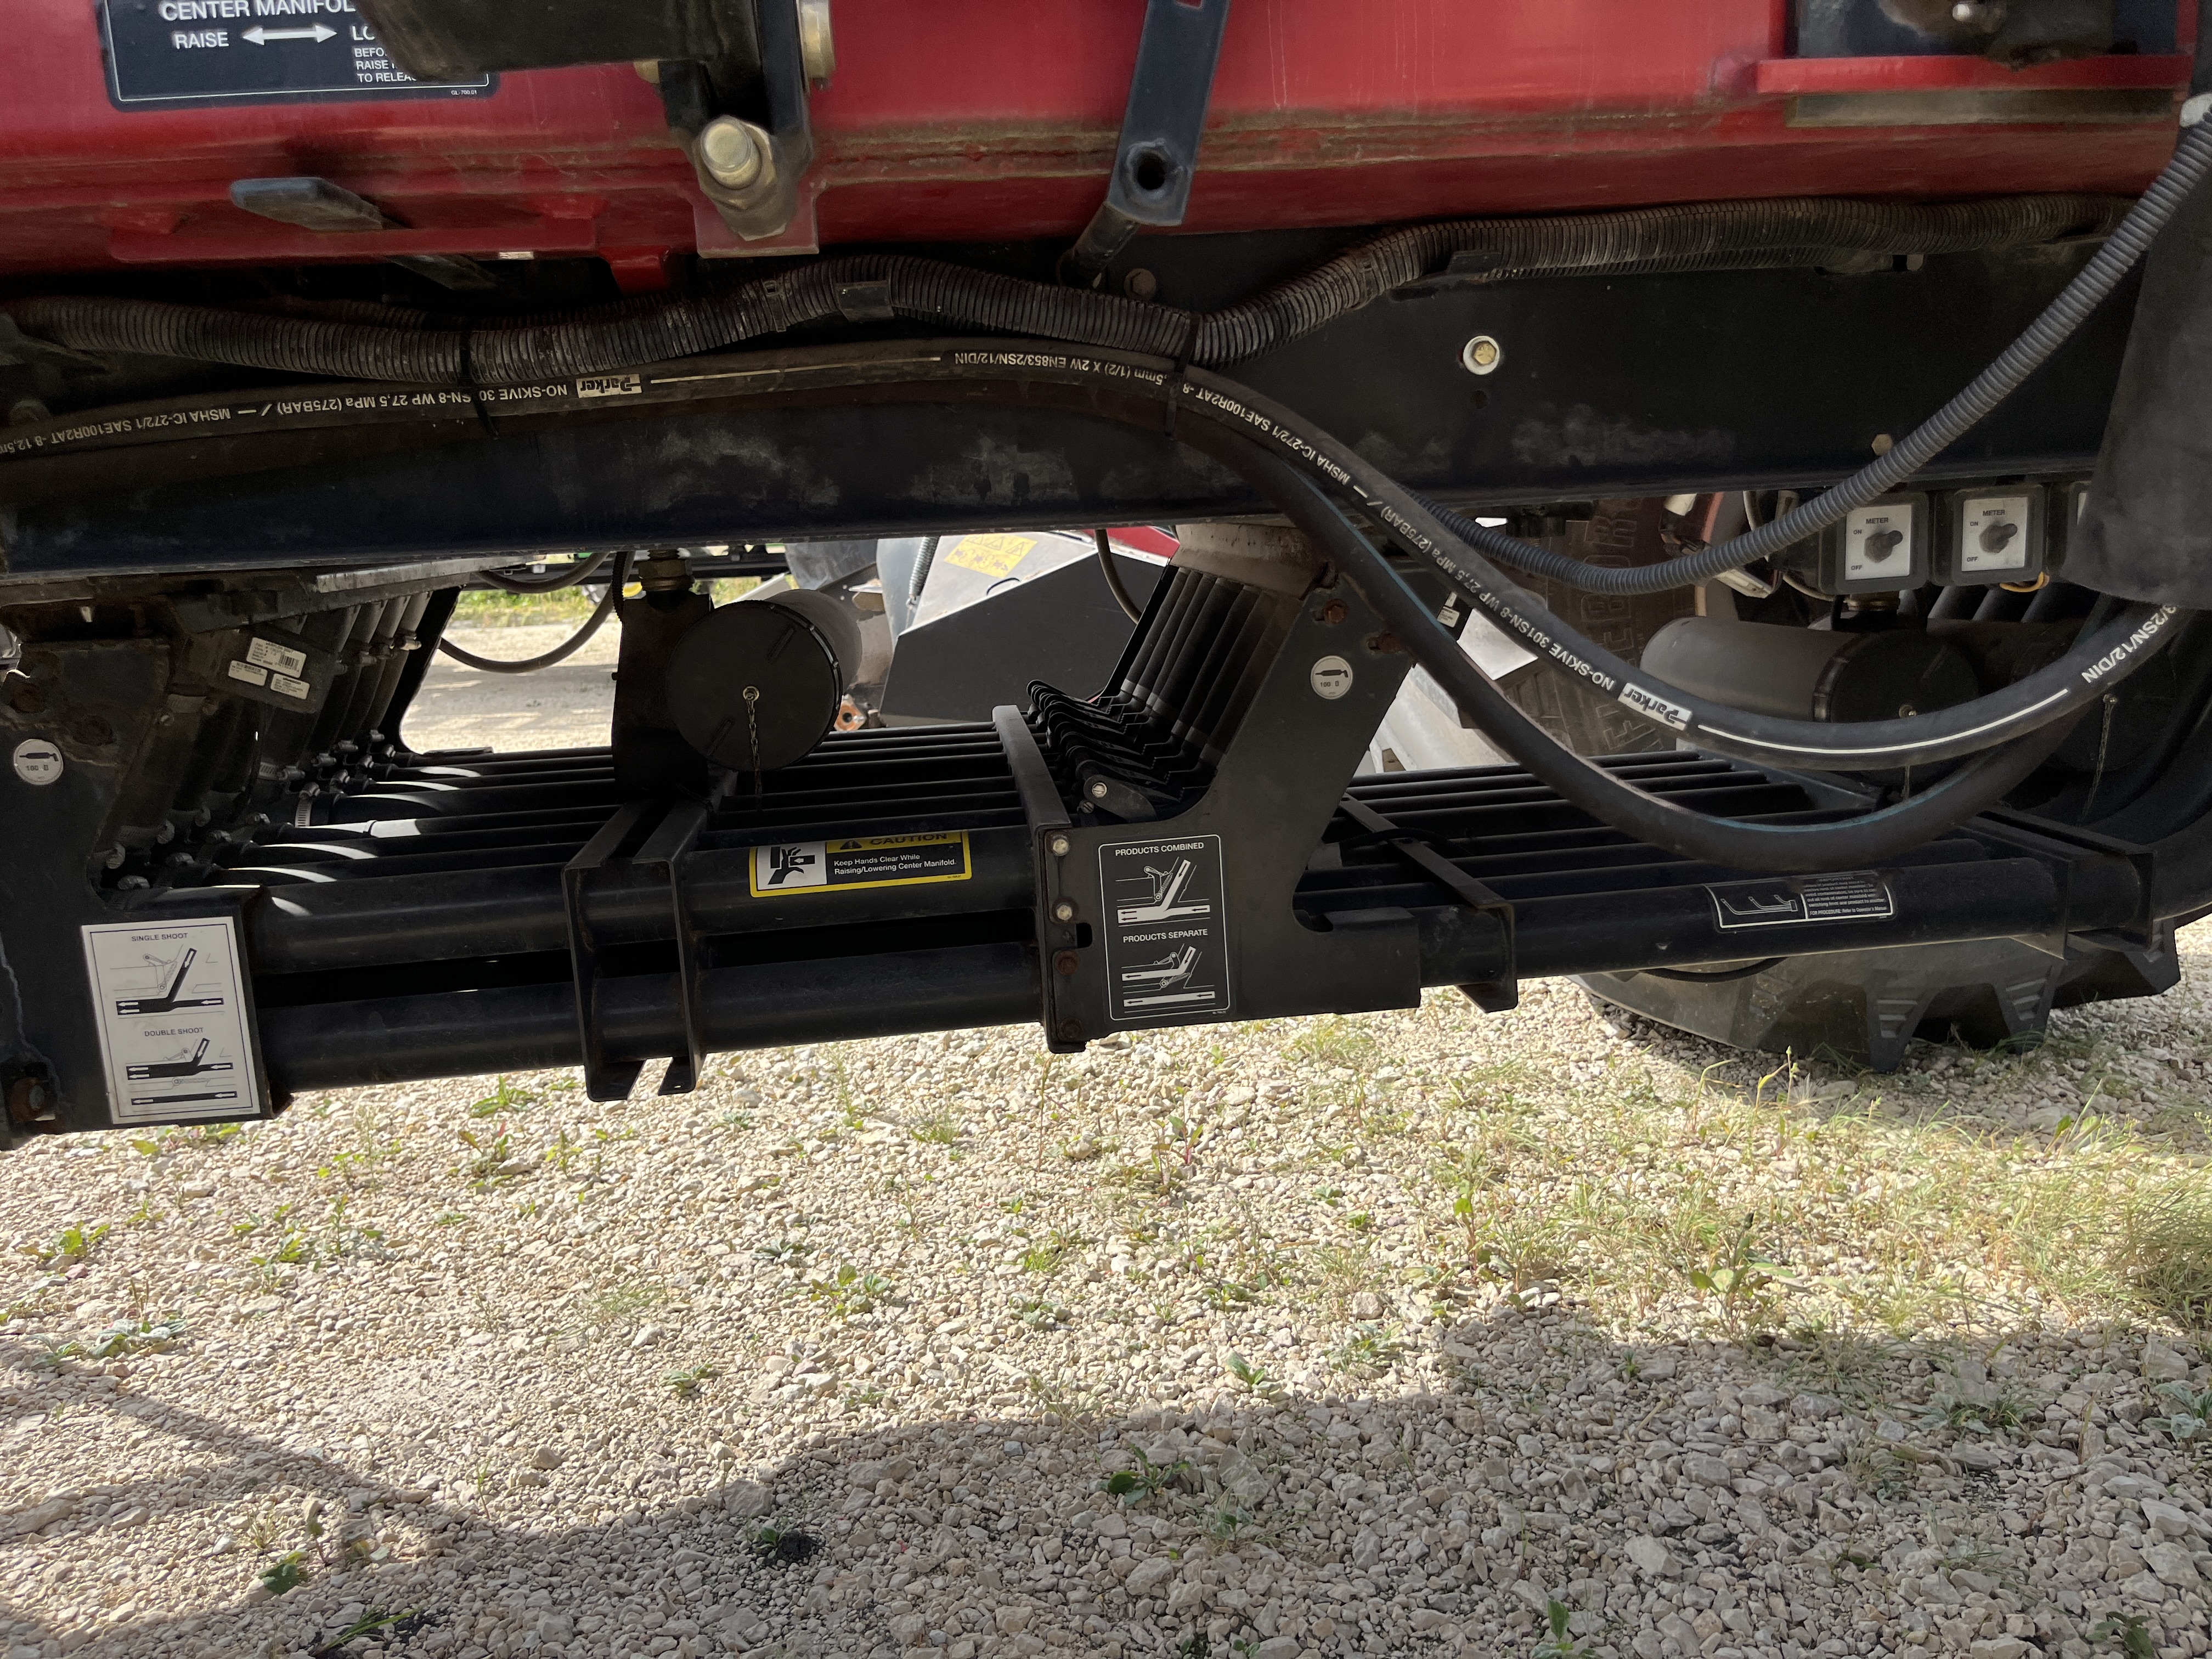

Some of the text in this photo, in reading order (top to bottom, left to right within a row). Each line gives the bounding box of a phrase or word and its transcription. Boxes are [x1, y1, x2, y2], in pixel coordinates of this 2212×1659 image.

[163, 0, 356, 21] CENTER MANIFOL
[174, 32, 229, 49] RAISE
[354, 47, 386, 58] BEFO
[356, 60, 389, 70] RAISE
[357, 72, 417, 83] TO RELEA
[954, 352, 1067, 369] EN853/2SN/12/DIN
[1070, 358, 1090, 371] 2W
[1104, 363, 1130, 379] (1/2)
[278, 374, 641, 416] Parker NO-SKIVE 30SN-8 WP 27,5 MPa (275BAR)
[191, 408, 231, 422] MSHA
[1195, 386, 1271, 432] SAE100R2AT
[137, 413, 188, 430] IC-272/1
[51, 420, 132, 444] SAE100R2AT
[0, 438, 31, 453] 12,5m
[1272, 425, 1316, 461] IC-272/1
[1316, 454, 1351, 487] MSHA
[1379, 505, 1433, 555] (275BAR)
[1431, 546, 1458, 573] MPa
[1454, 566, 1482, 595] 27,5
[1479, 591, 1500, 614] WP
[1499, 605, 1555, 649] 301SN-8
[2081, 602, 2178, 684] 3/2SN/12/DIN
[1548, 642, 1615, 692] NO-SKIVE
[1621, 683, 1691, 730] Parker
[871, 833, 947, 845] CAUTION
[1115, 842, 1204, 856] PRODUCTS COMBINED
[834, 860, 853, 868] Keep
[855, 857, 878, 865] Hands
[879, 855, 899, 863] Clear
[834, 864, 897, 876] Raising/Lowering
[898, 861, 922, 870] Center
[131, 934, 159, 942] SINGLE
[1123, 929, 1208, 943] PRODUCTS SEPARATE
[144, 1028, 176, 1037] DOUBLE
